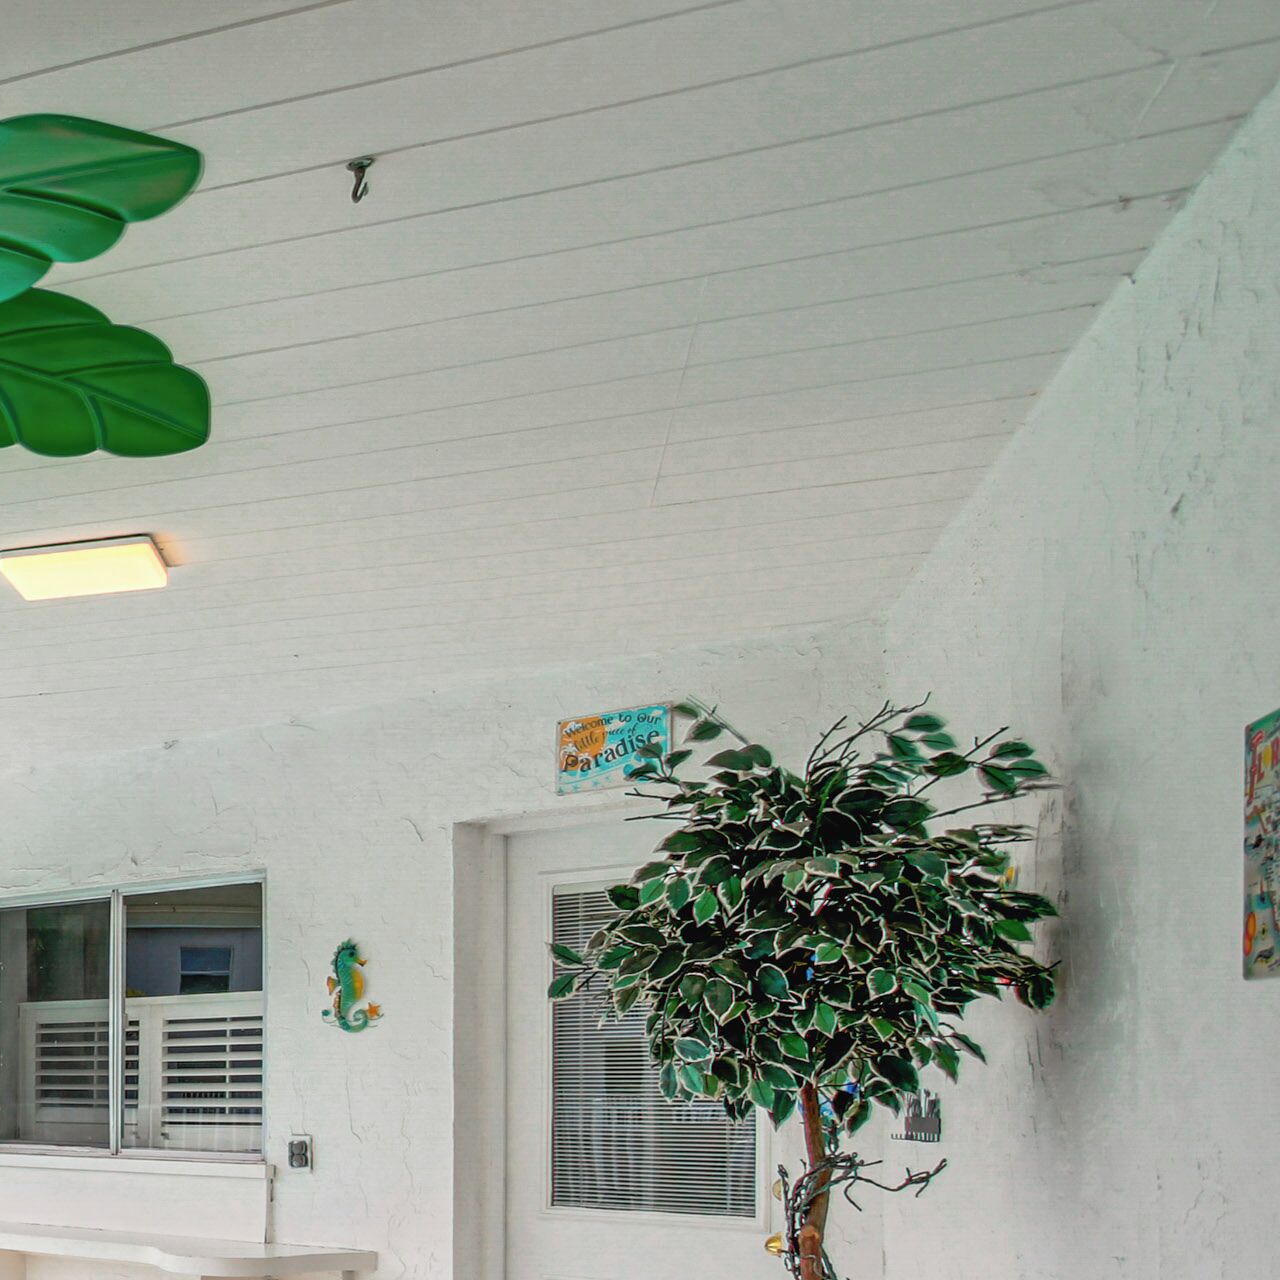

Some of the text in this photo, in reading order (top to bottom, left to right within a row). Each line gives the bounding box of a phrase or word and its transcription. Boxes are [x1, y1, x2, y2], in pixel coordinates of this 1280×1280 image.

[564, 712, 661, 737] Welcome to Our
[627, 722, 638, 737] of
[561, 730, 660, 772] Paradise
